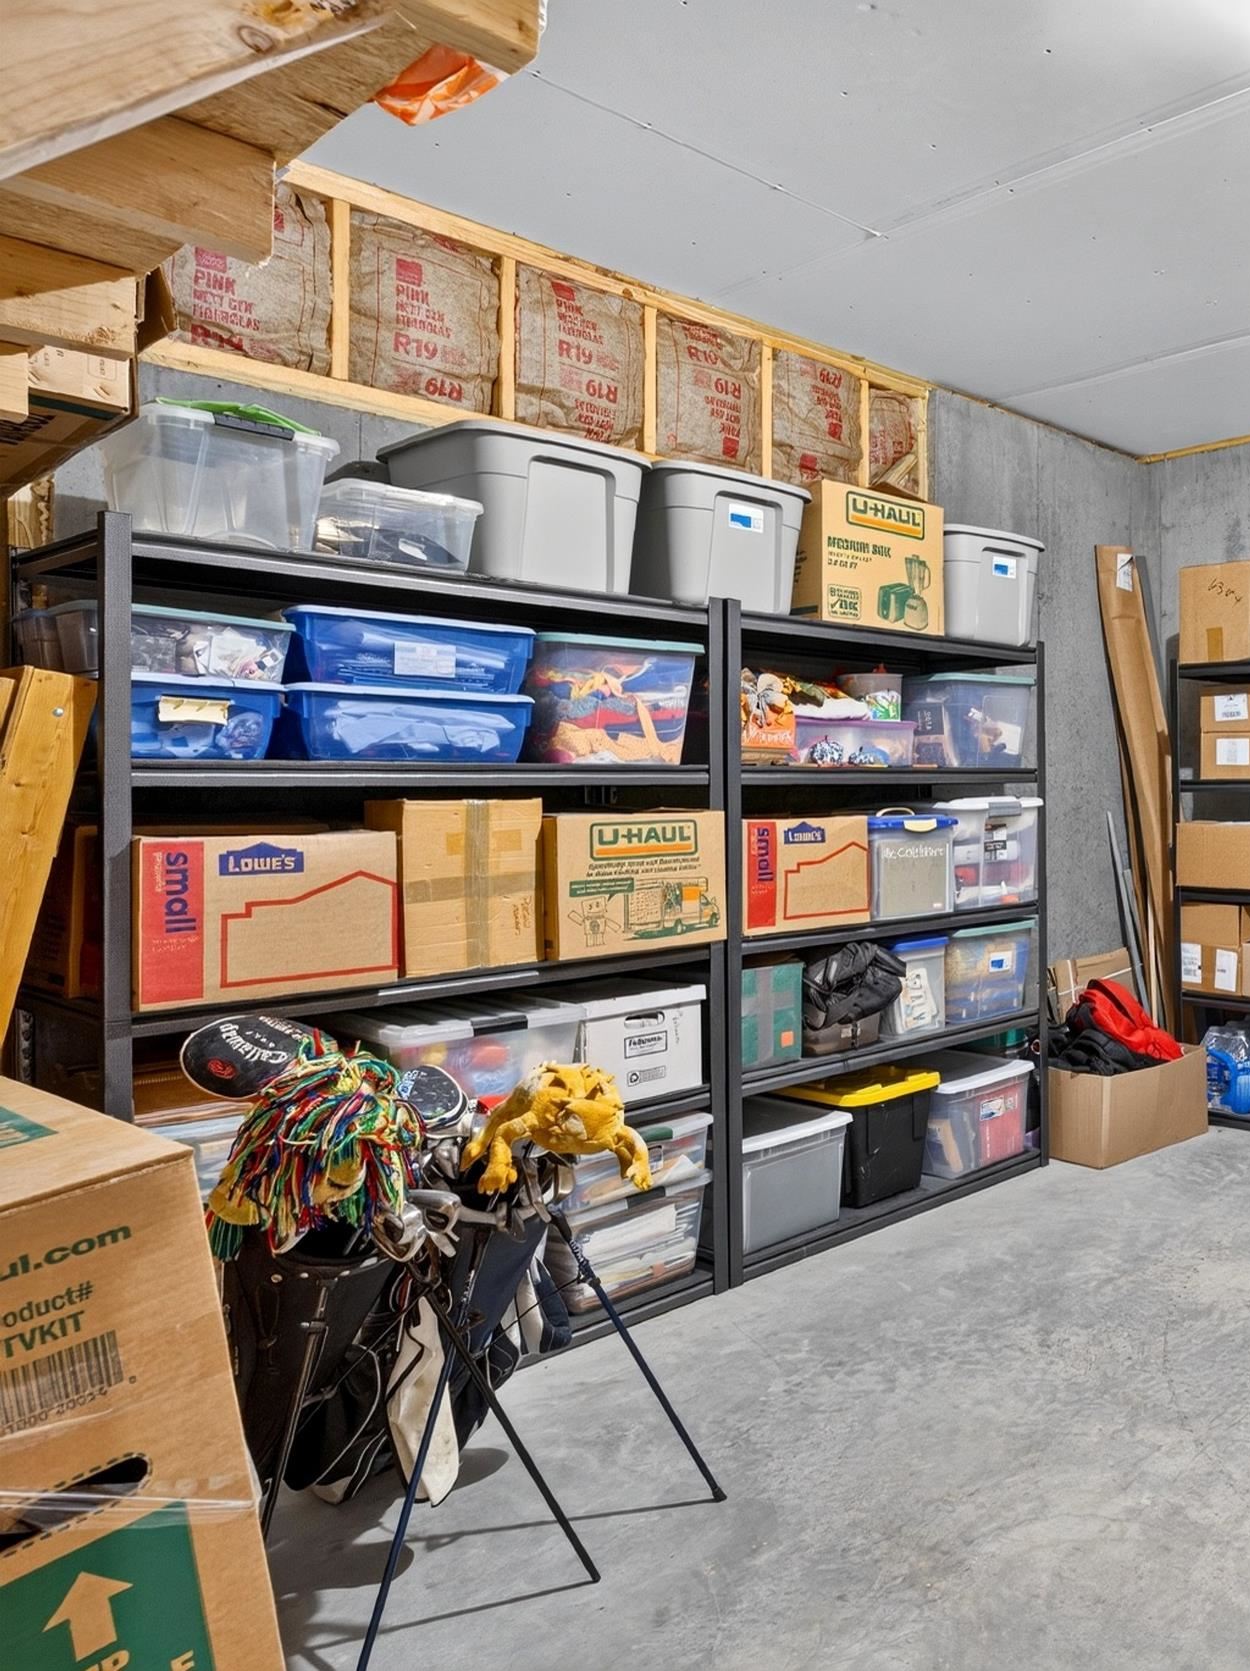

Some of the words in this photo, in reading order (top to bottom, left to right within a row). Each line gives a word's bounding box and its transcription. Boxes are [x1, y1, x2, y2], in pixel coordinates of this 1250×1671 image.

[194, 268, 236, 296] PINK
[393, 331, 438, 360] R19
[557, 339, 593, 365] R19
[424, 376, 463, 402] R19
[585, 378, 618, 404] R19
[714, 377, 742, 400] R19
[852, 497, 921, 527] U-HAUL
[597, 825, 692, 846] U-HAUL
[227, 853, 296, 873] LOWE'S
[757, 827, 774, 882] small
[164, 852, 197, 934] small
[219, 1022, 289, 1065] Callaway
